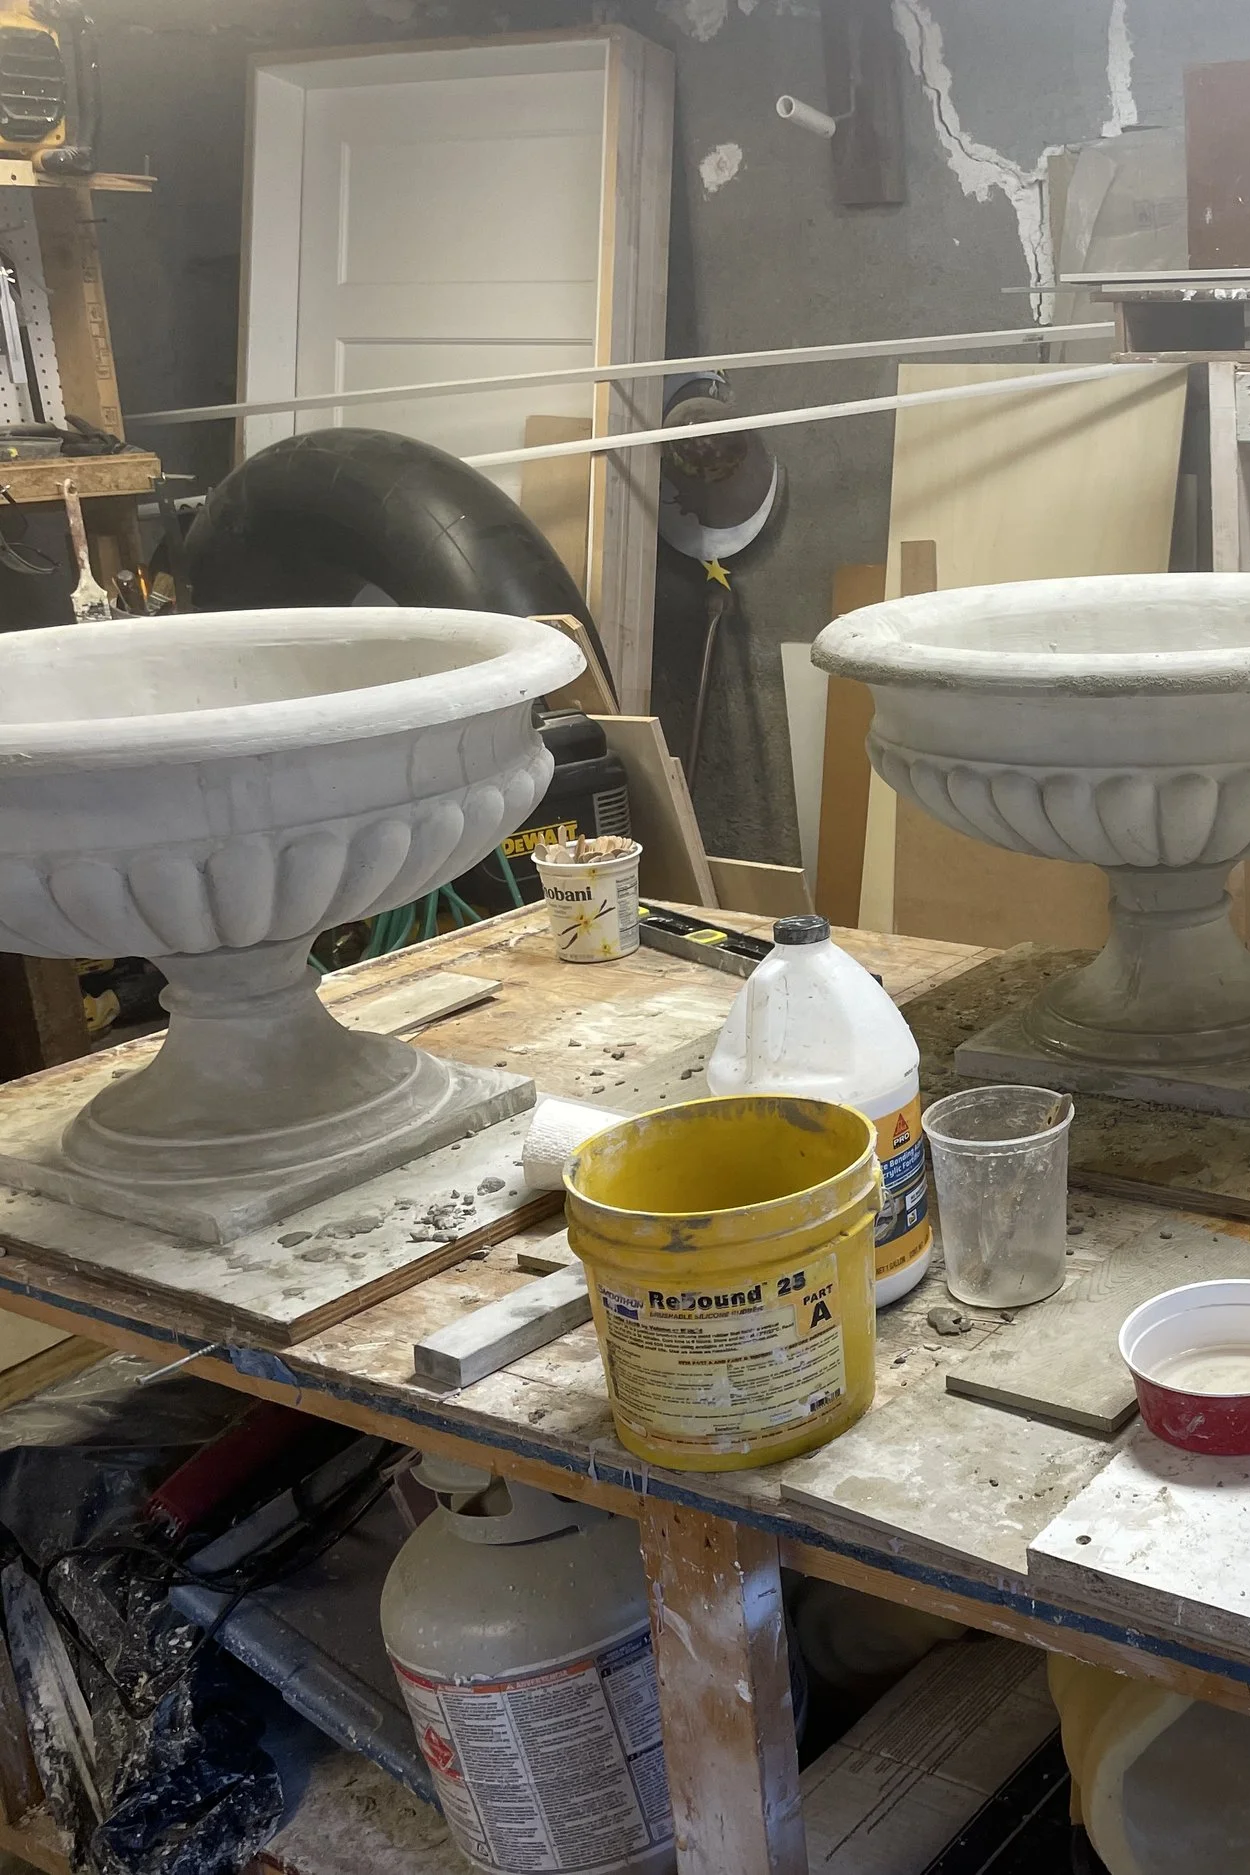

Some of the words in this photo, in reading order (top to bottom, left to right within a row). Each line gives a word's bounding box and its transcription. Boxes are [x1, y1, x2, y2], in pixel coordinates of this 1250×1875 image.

[501, 823, 577, 855] DEWAT
[893, 1132, 910, 1147] PRO
[882, 1165, 902, 1179] crylic
[777, 1271, 806, 1297] 25
[803, 1284, 834, 1306] PART
[809, 1300, 833, 1329] A
